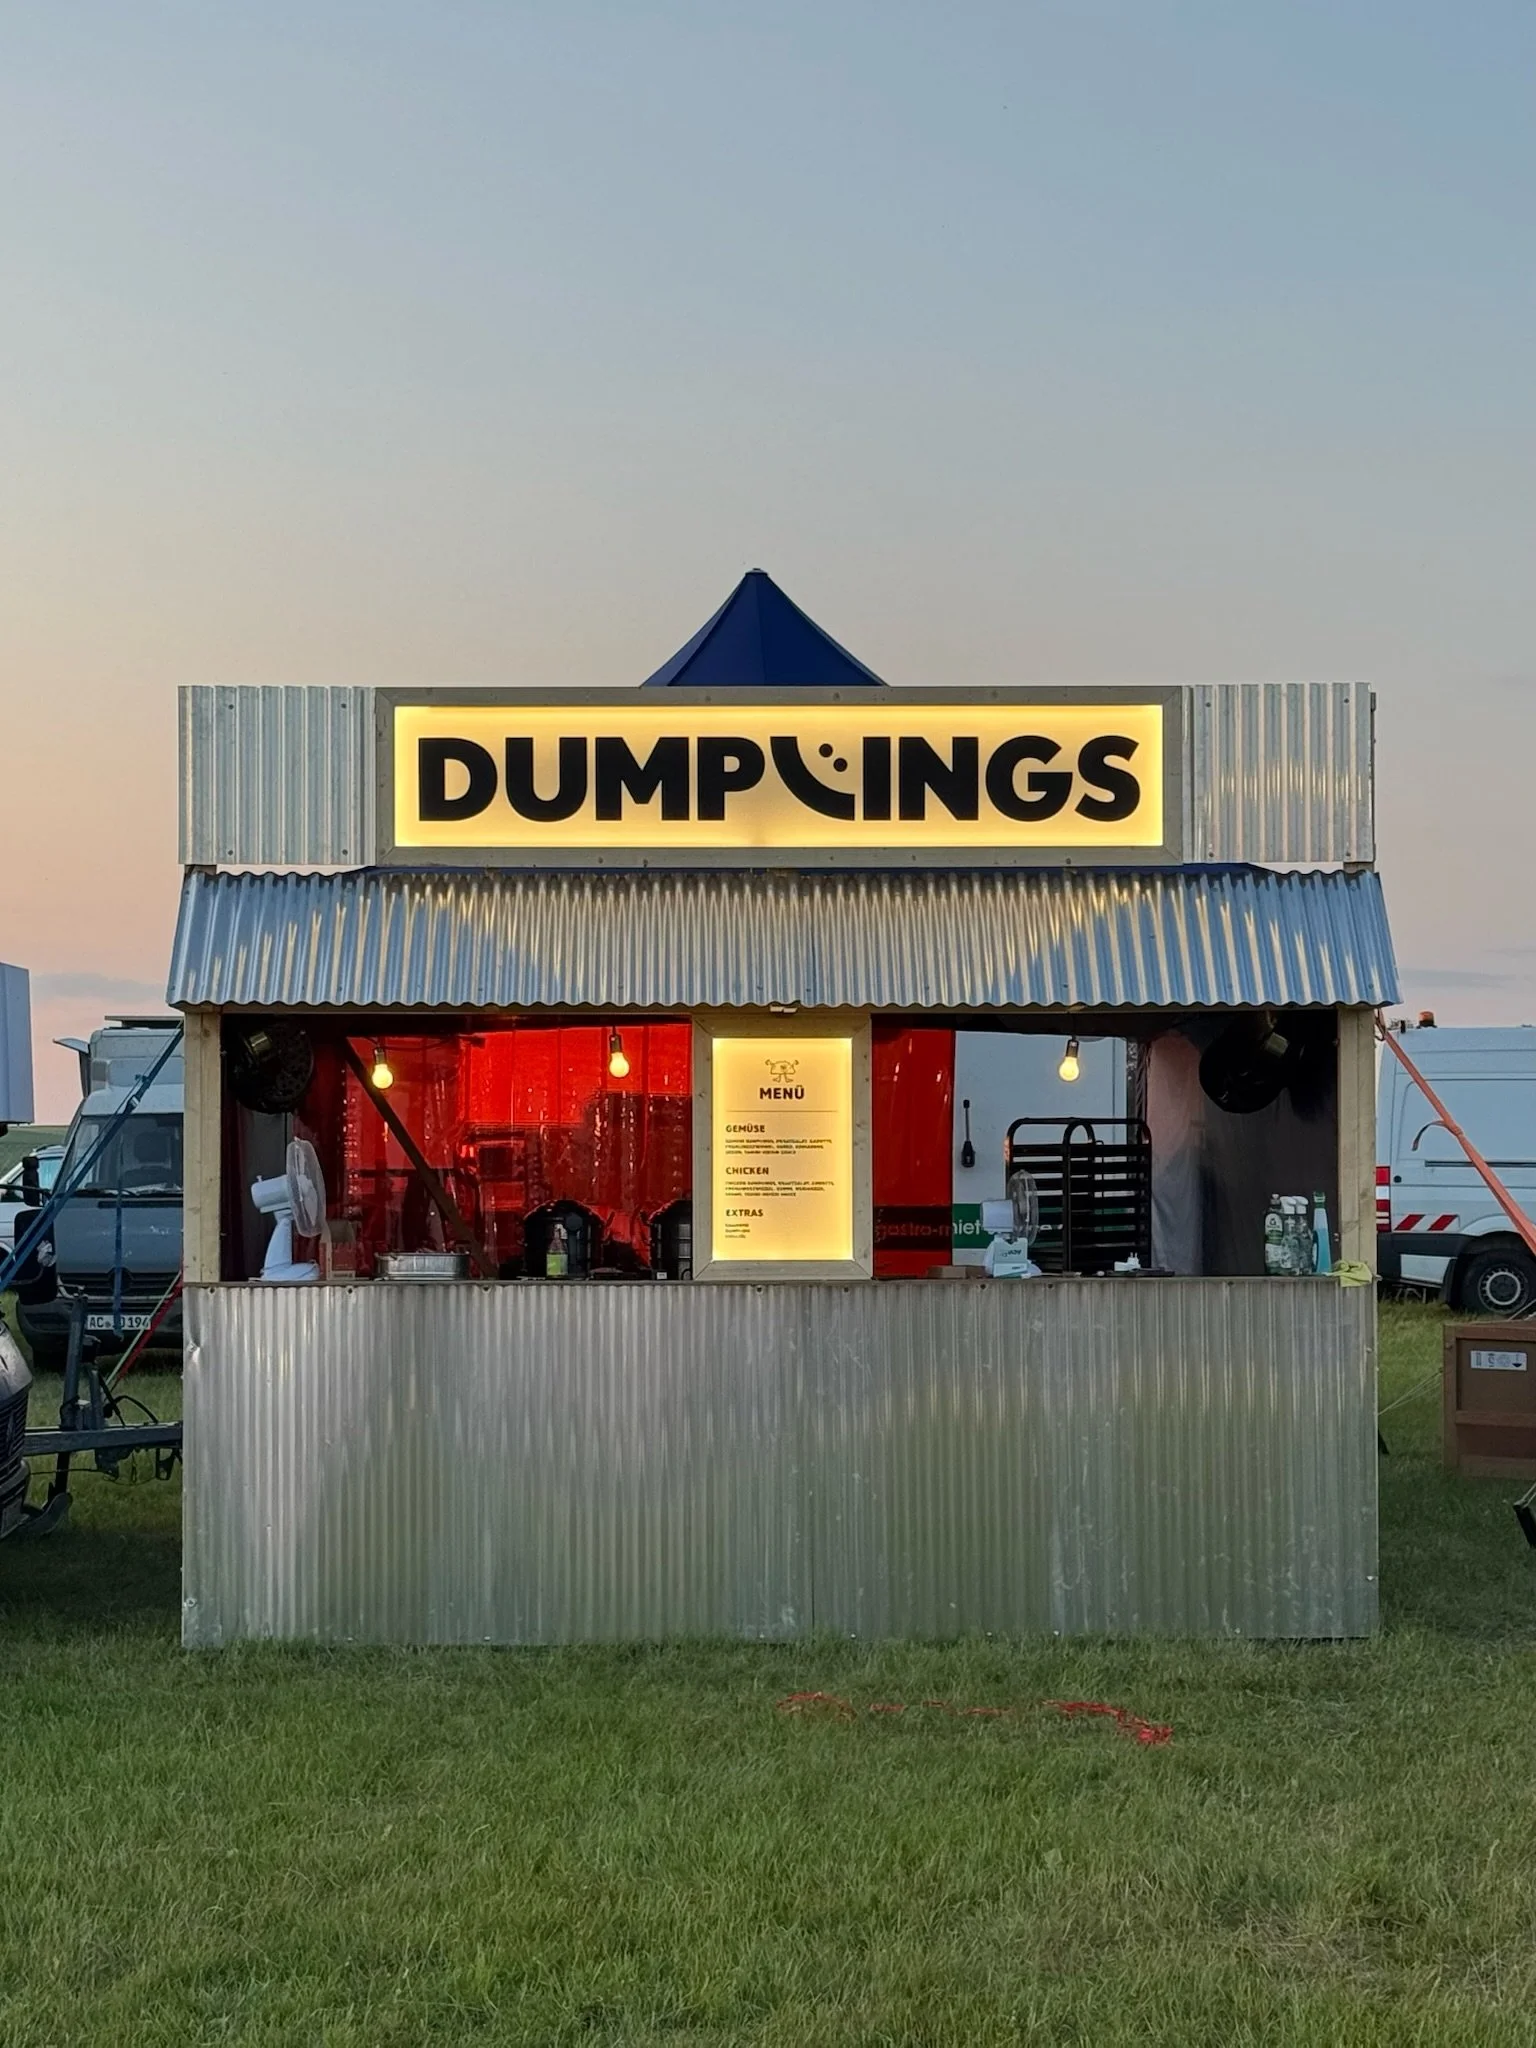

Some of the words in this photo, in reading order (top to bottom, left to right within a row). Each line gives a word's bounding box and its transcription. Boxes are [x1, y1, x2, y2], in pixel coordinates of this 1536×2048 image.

[417, 735, 1141, 822] DUMPLINGS
[759, 1085, 805, 1099] MENÜ
[725, 1123, 766, 1133] GEMÜSE
[725, 1166, 770, 1175] CHICKEN
[725, 1208, 764, 1217] EXTRAS
[90, 1316, 104, 1328] AC
